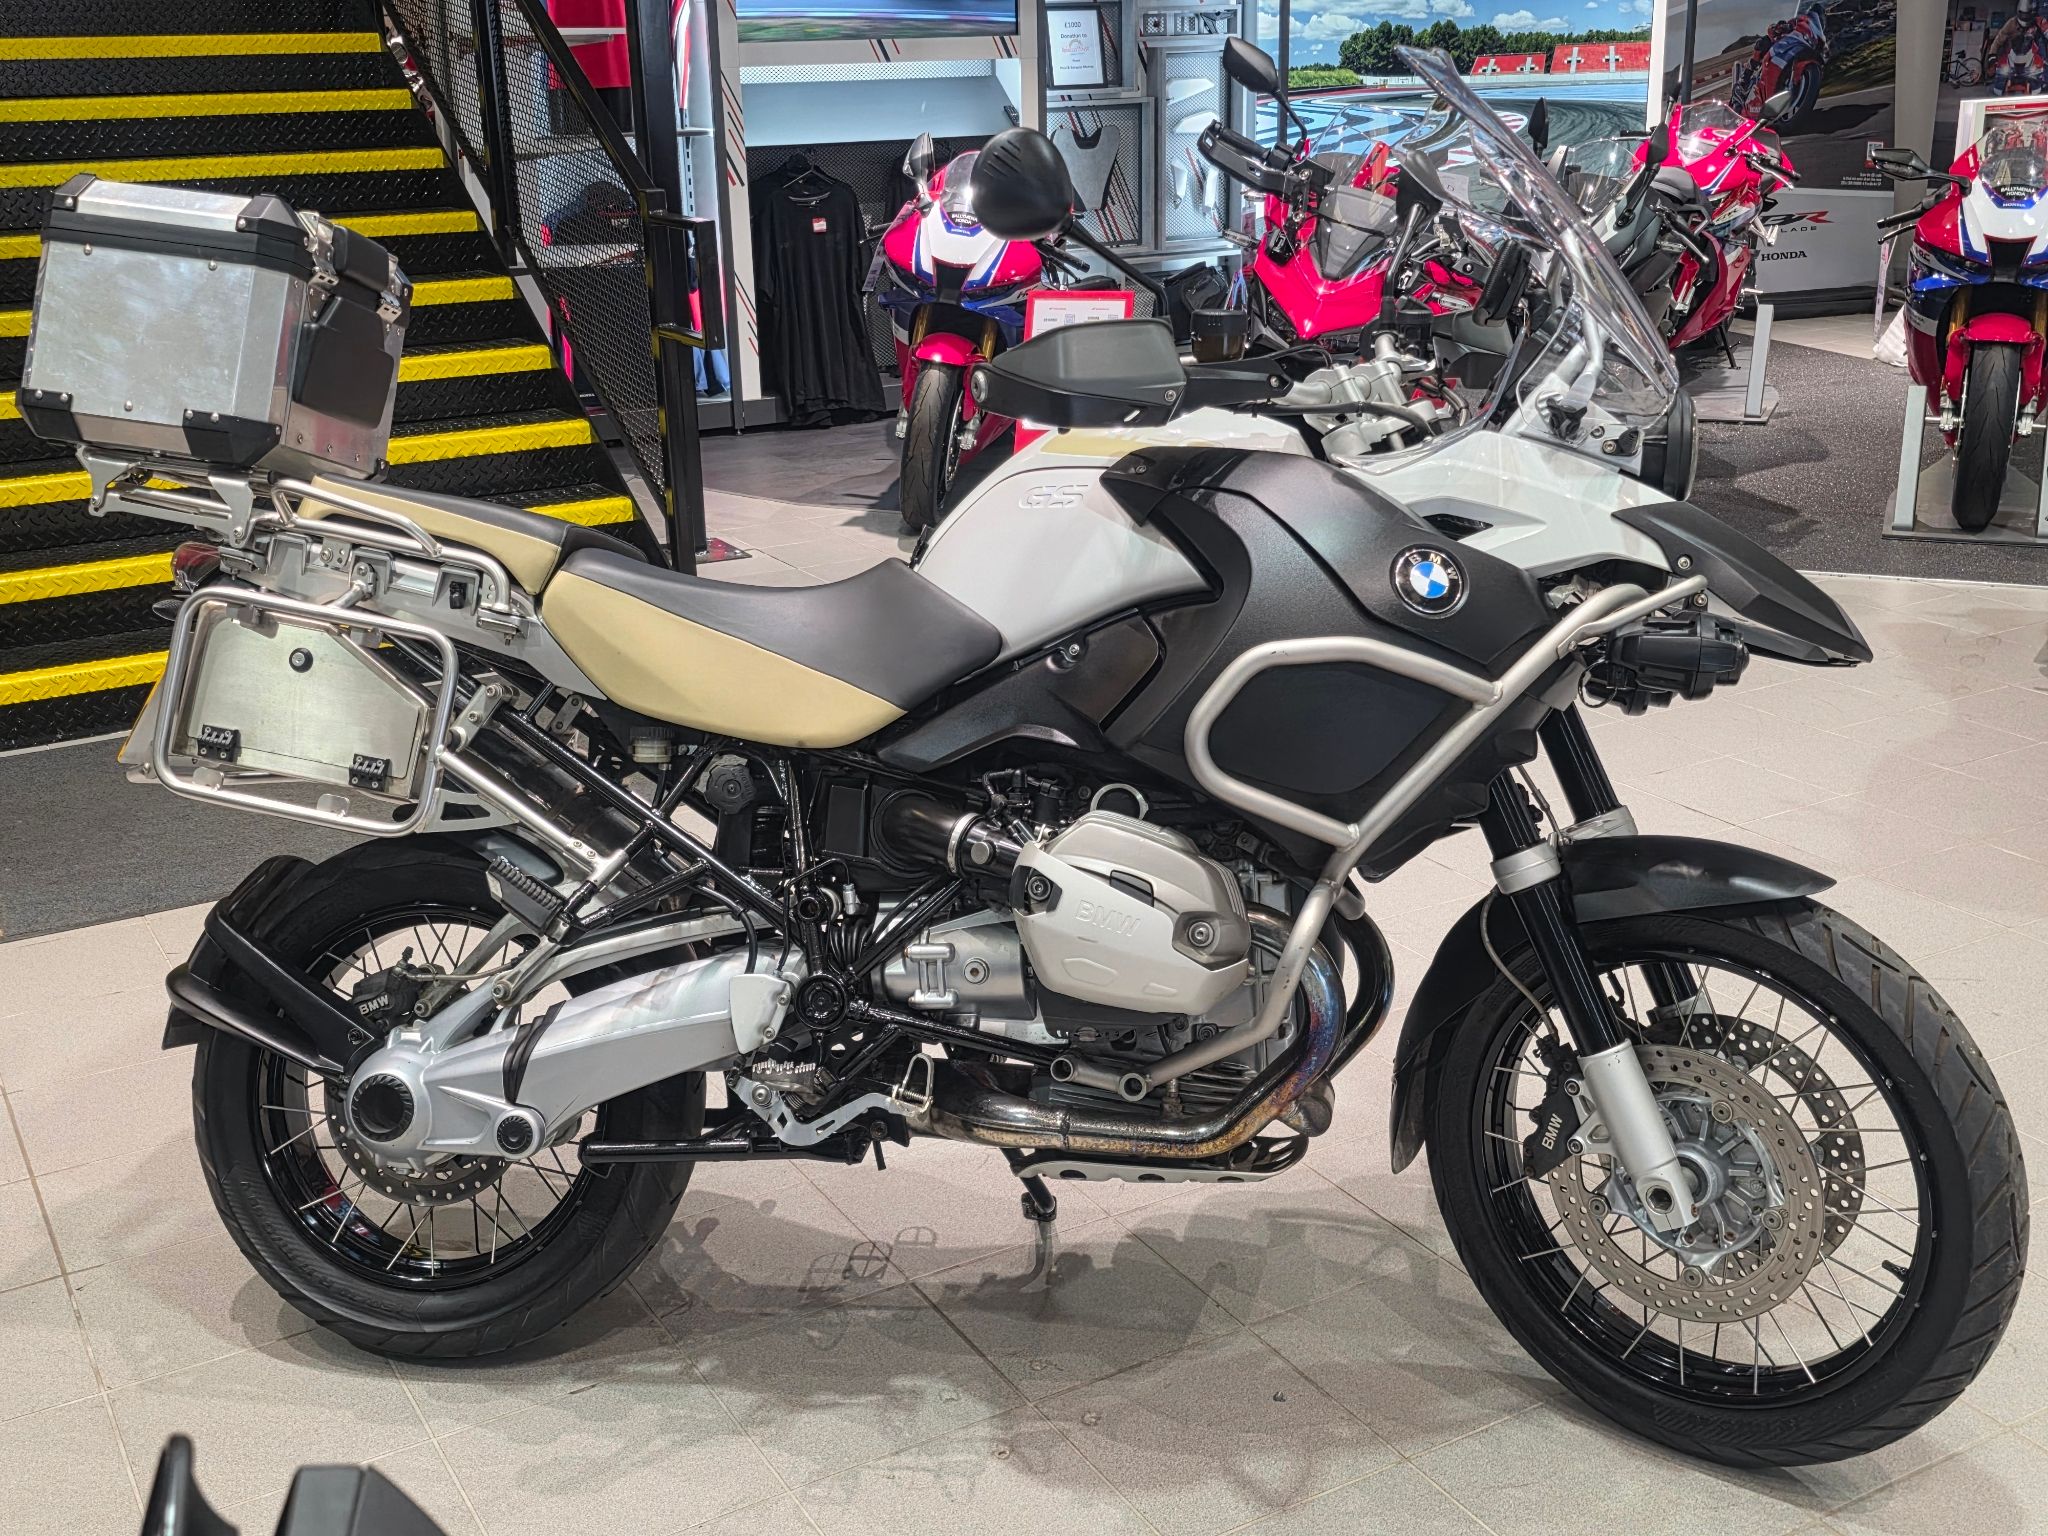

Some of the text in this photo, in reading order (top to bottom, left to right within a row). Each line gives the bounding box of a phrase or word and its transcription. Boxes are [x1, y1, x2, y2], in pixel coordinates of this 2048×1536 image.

[1760, 211, 1835, 226] BR
[1780, 225, 1817, 233] LADE
[1761, 250, 1808, 262] HONDA
[1407, 552, 1459, 580] BMW
[1074, 898, 1143, 938] BMW
[358, 994, 390, 1016] BMW
[1541, 1112, 1563, 1151] BMW
